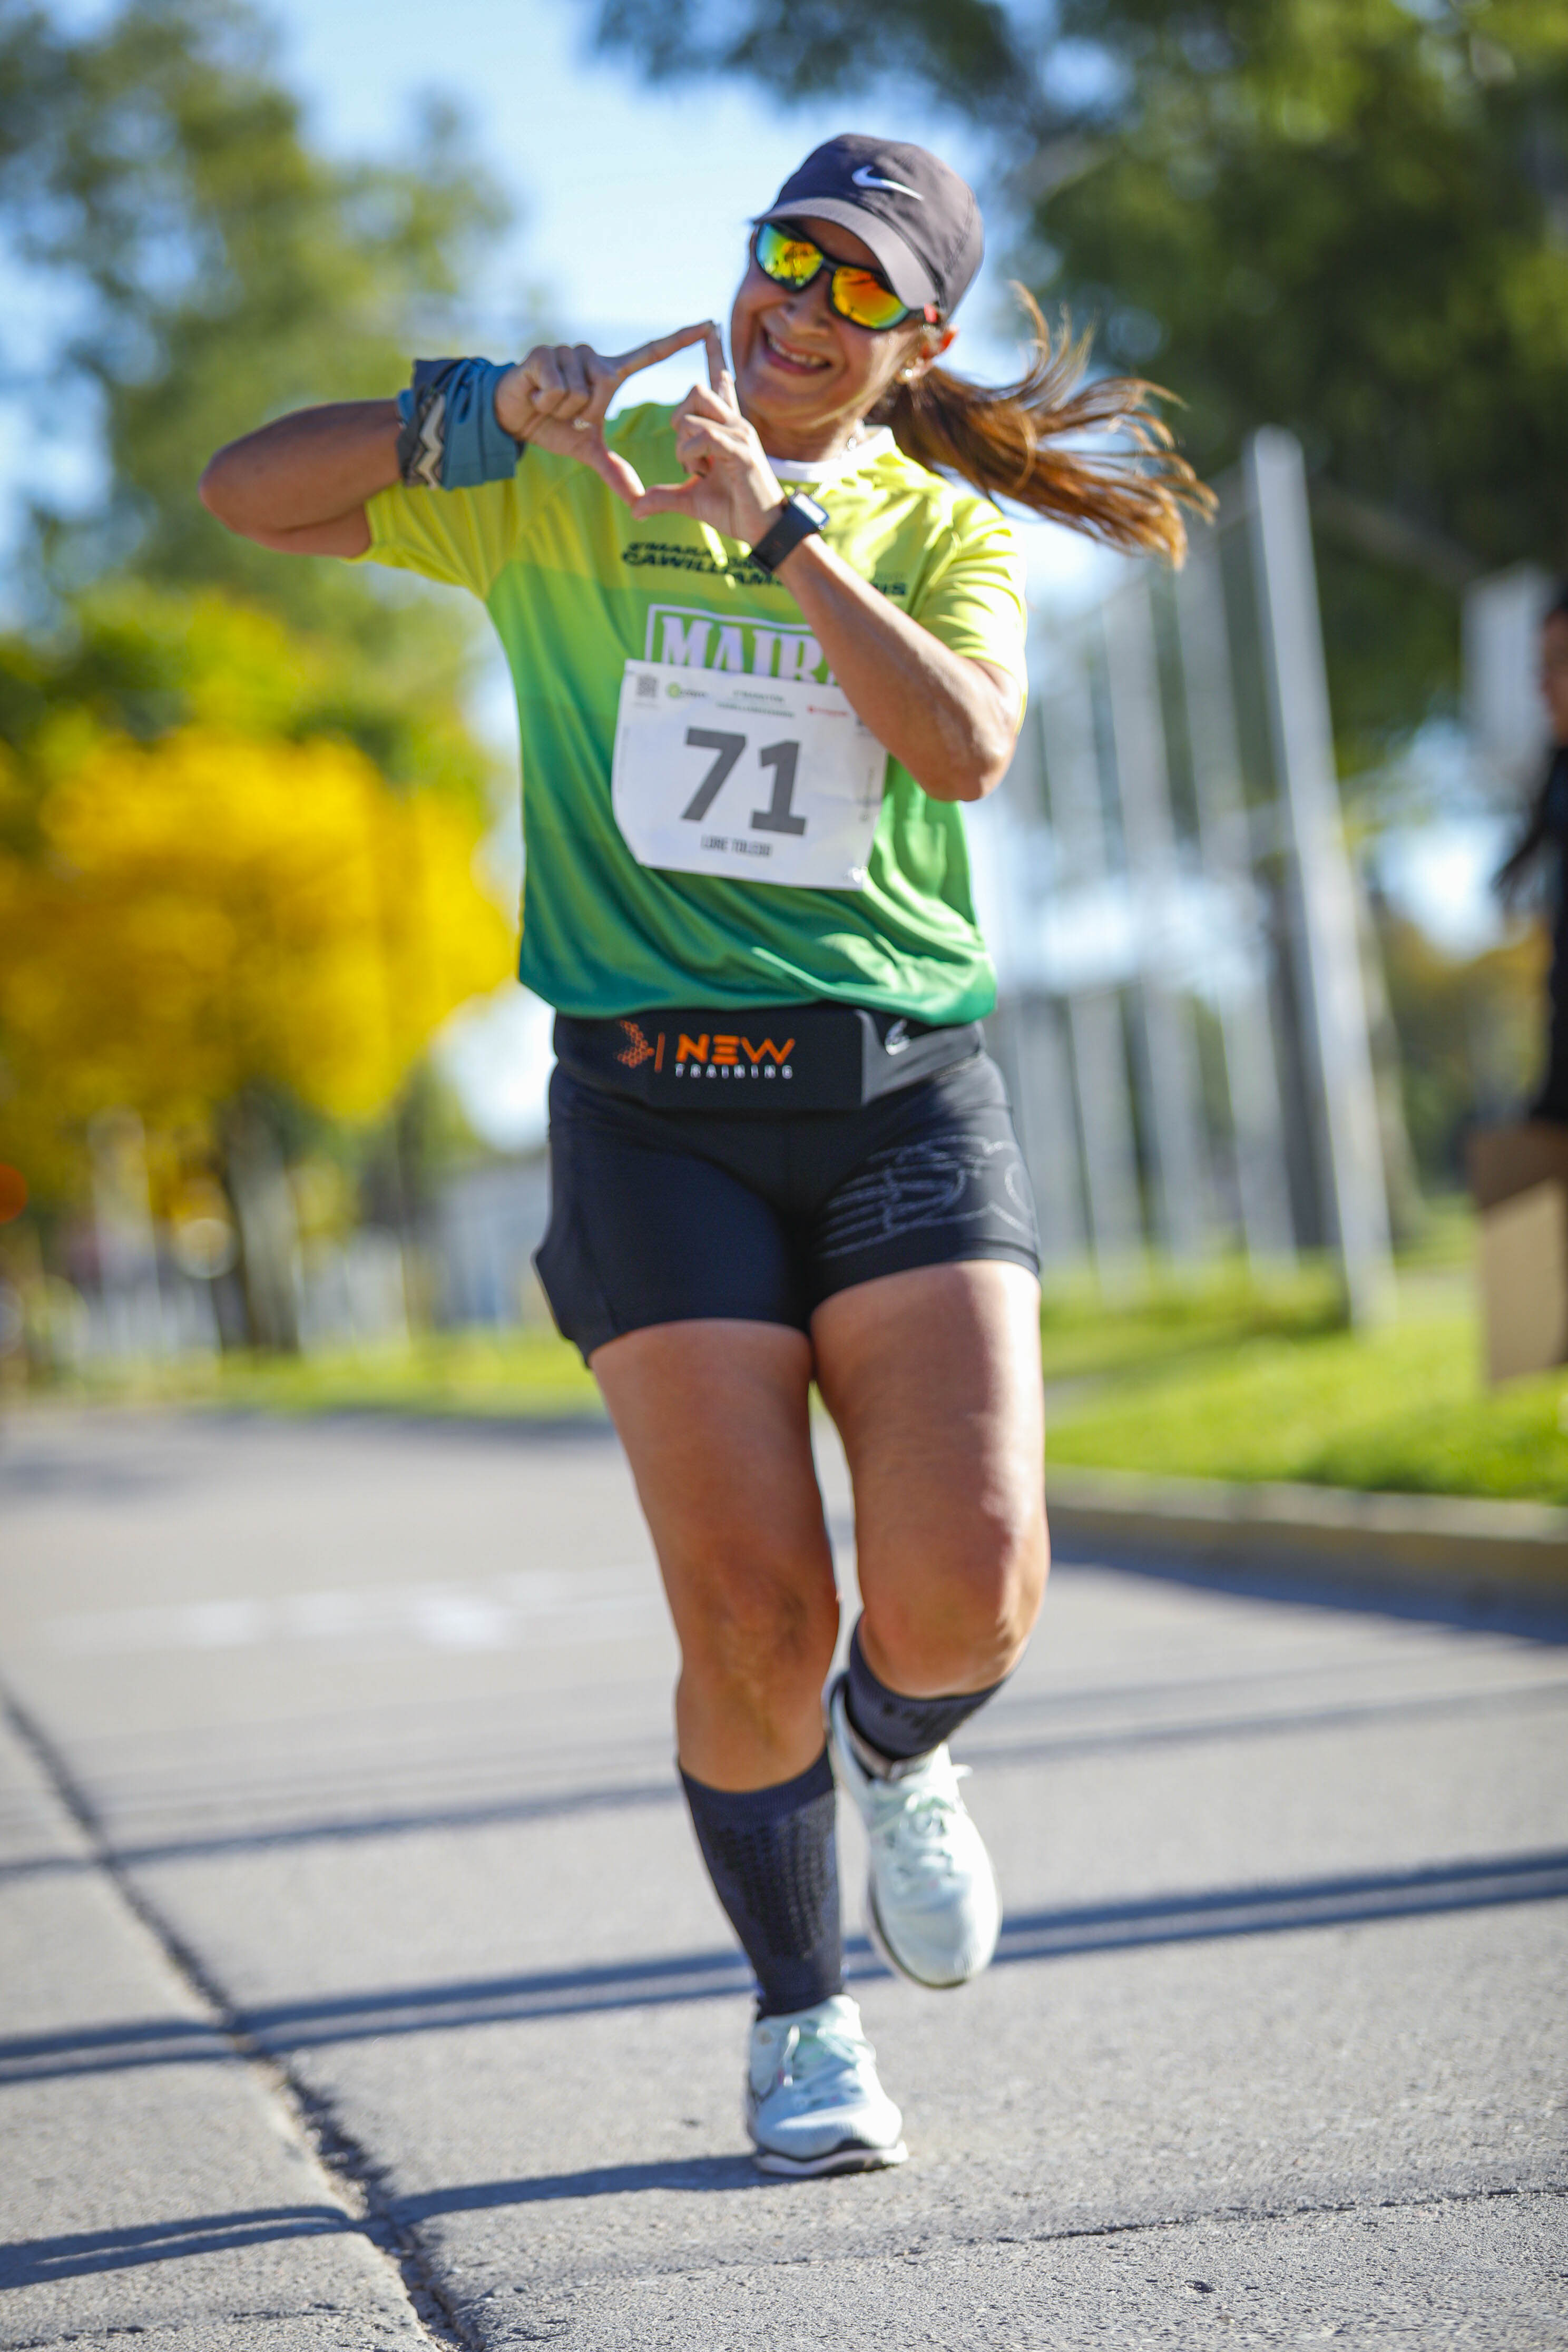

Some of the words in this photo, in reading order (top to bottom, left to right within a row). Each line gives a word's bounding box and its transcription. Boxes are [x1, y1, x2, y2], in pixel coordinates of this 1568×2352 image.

[681, 726, 807, 836] 71
[676, 1033, 796, 1065] NEW
[675, 1062, 793, 1080] TRAINING
